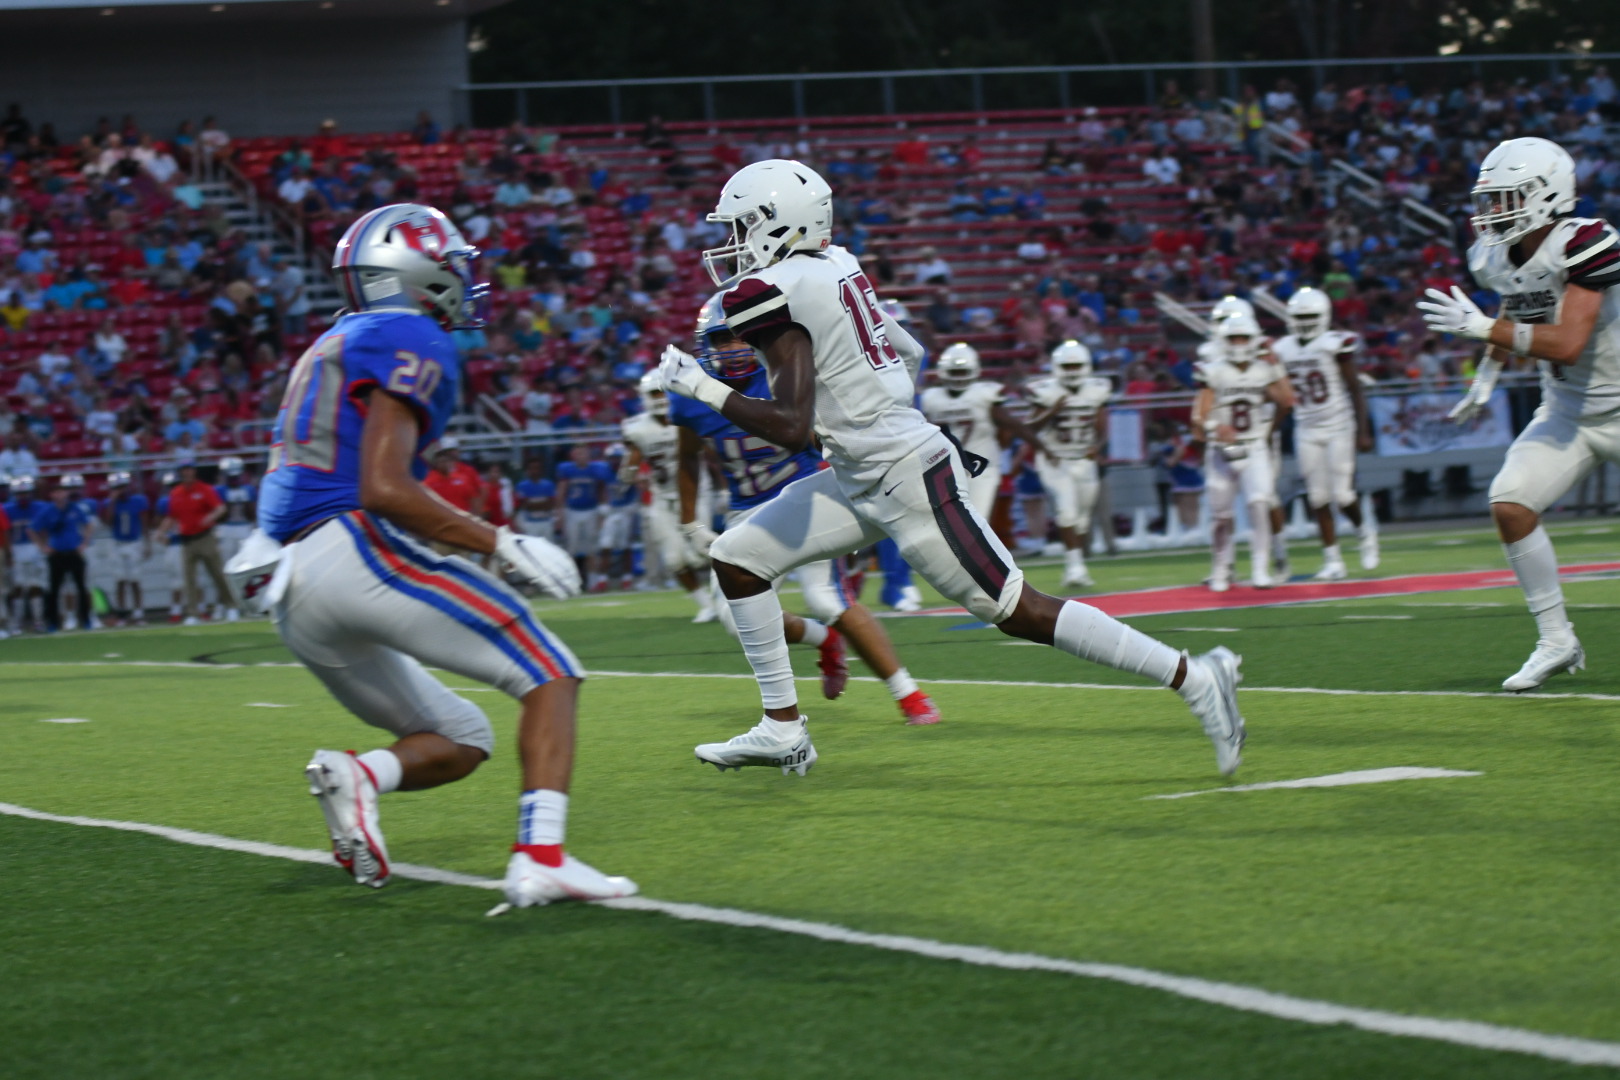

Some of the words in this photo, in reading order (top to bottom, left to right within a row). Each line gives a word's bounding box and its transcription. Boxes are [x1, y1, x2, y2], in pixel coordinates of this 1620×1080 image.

[387, 350, 442, 404] 20
[1232, 399, 1251, 432] 8
[721, 436, 799, 498] 12
